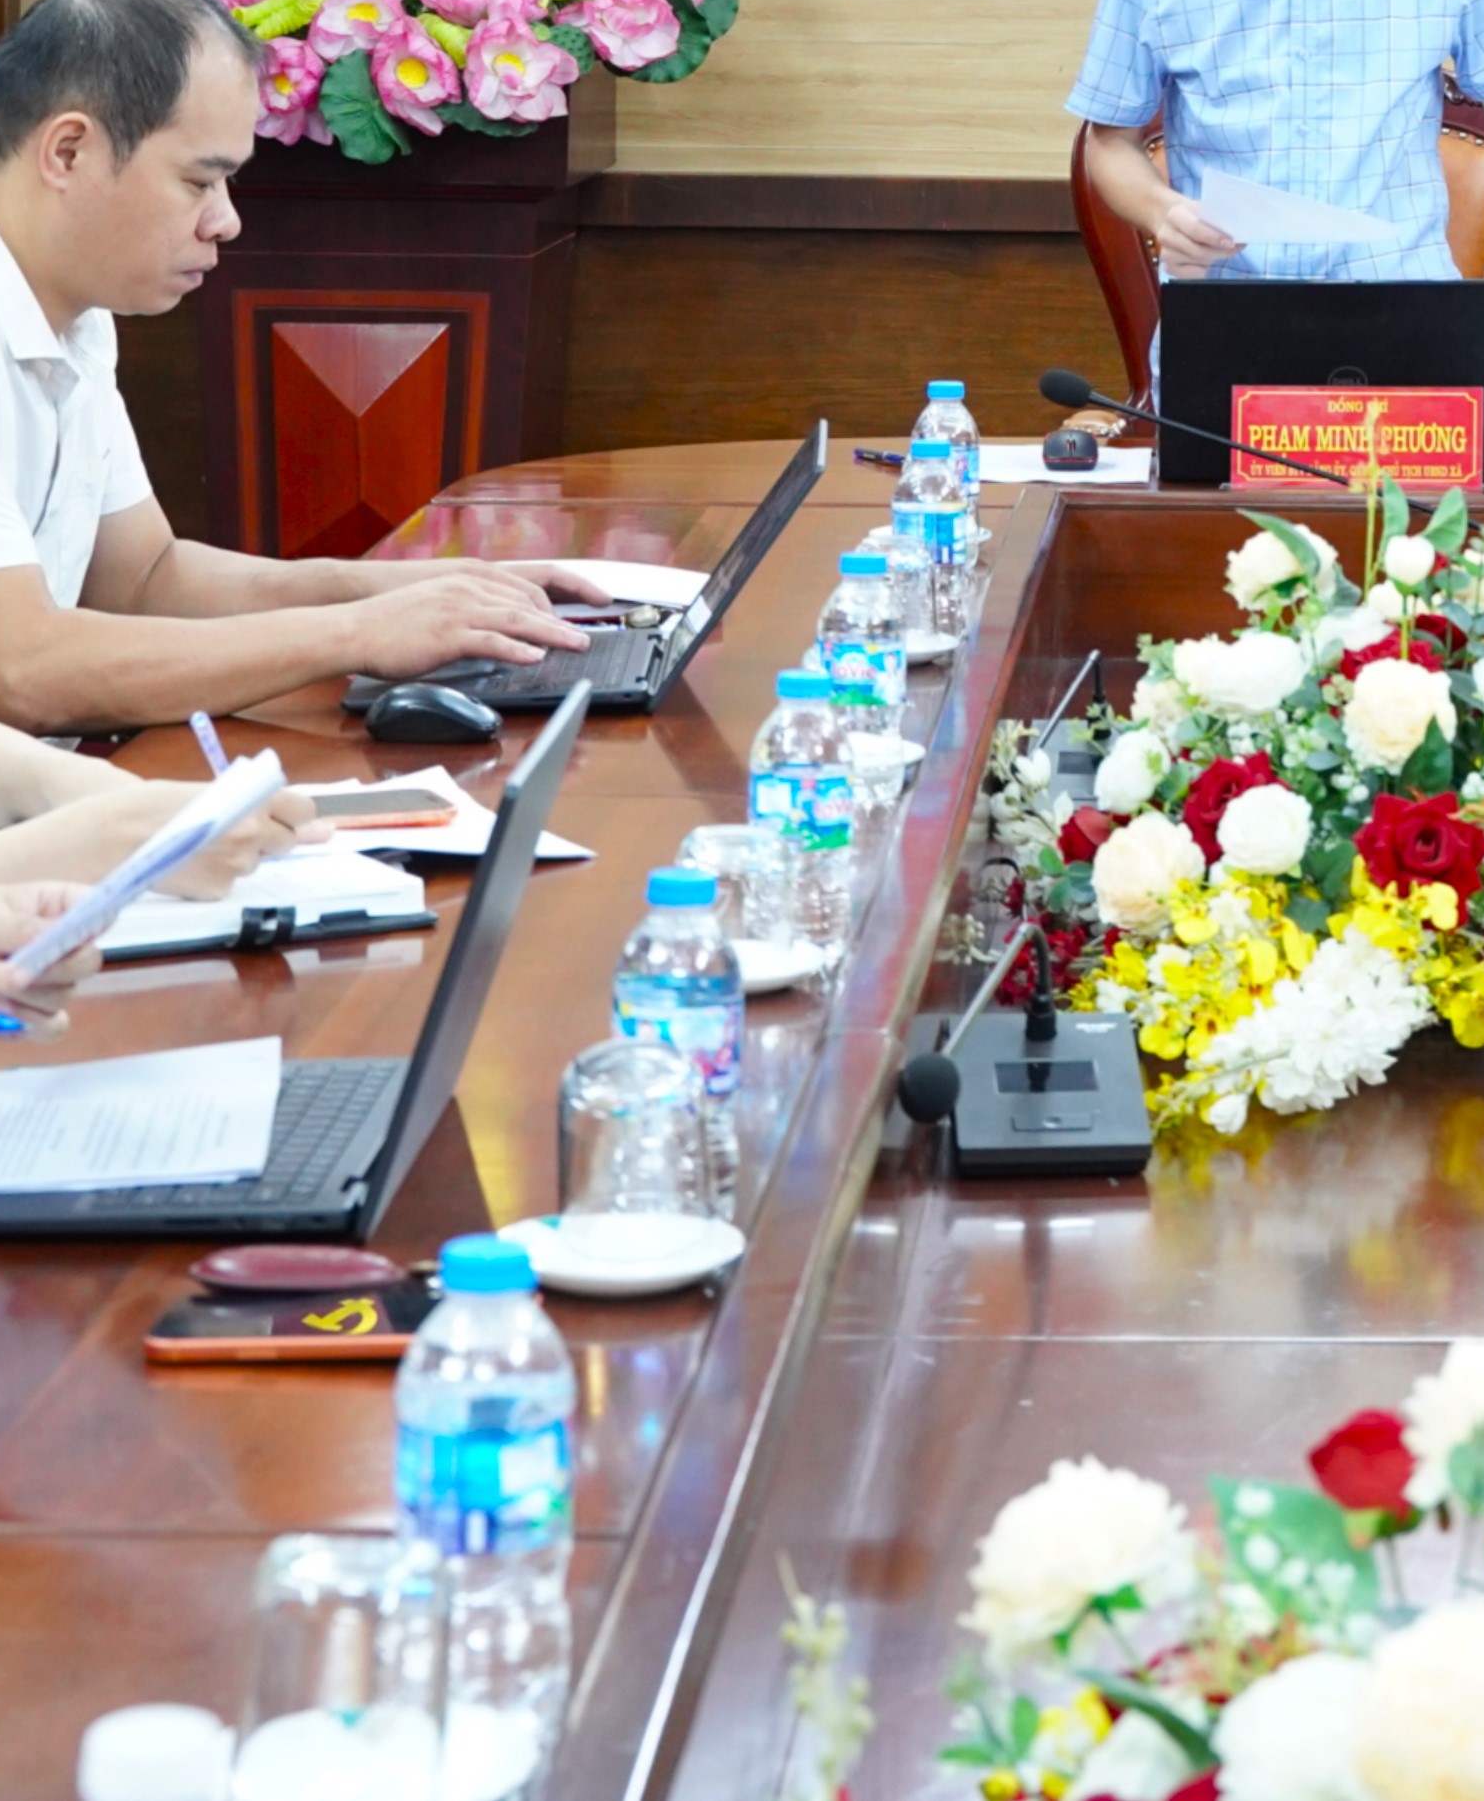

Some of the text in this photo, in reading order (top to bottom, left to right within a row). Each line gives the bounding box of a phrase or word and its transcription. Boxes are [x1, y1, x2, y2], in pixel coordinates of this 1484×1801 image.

[1248, 421, 1467, 459] PHẠM MINH PHƯƠNG
